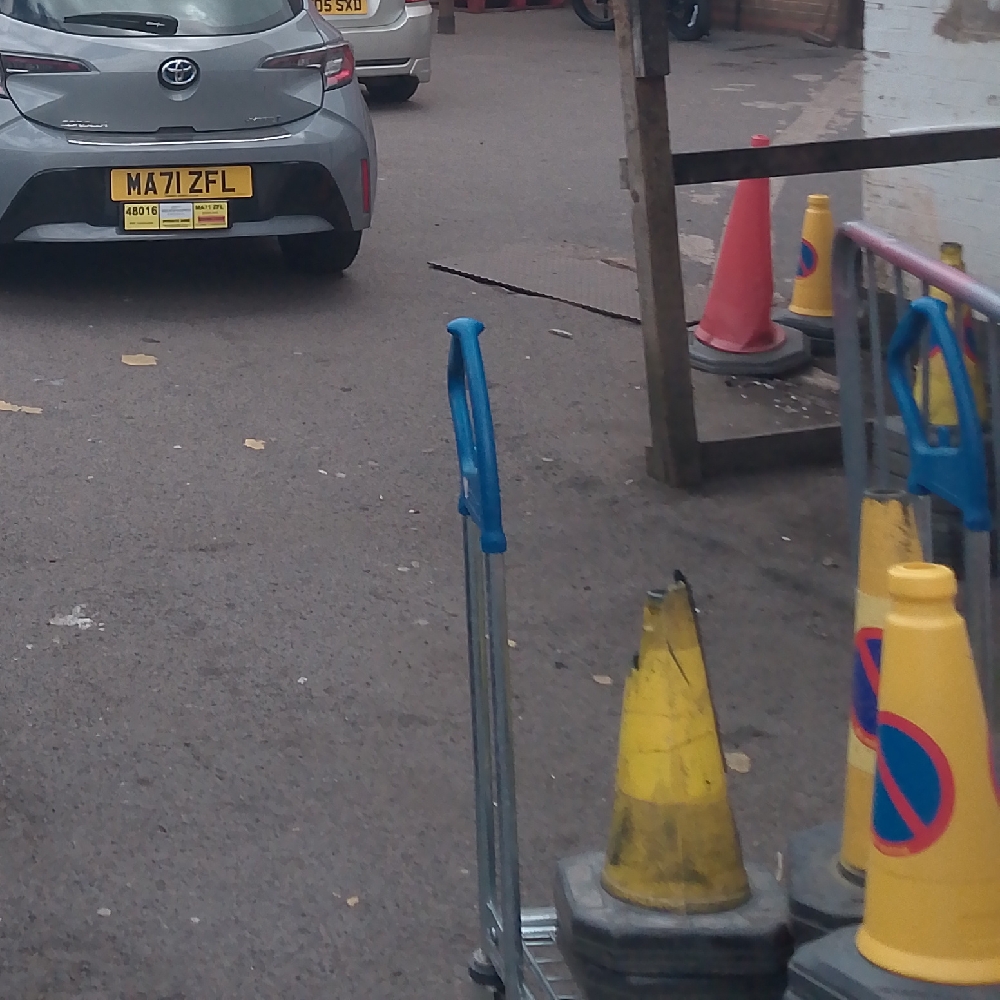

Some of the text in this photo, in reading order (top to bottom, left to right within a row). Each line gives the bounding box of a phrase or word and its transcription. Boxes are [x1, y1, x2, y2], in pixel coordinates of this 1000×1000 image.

[312, 0, 332, 12] 05
[127, 170, 235, 195] MA71 ZFL
[125, 205, 158, 216] 48016
